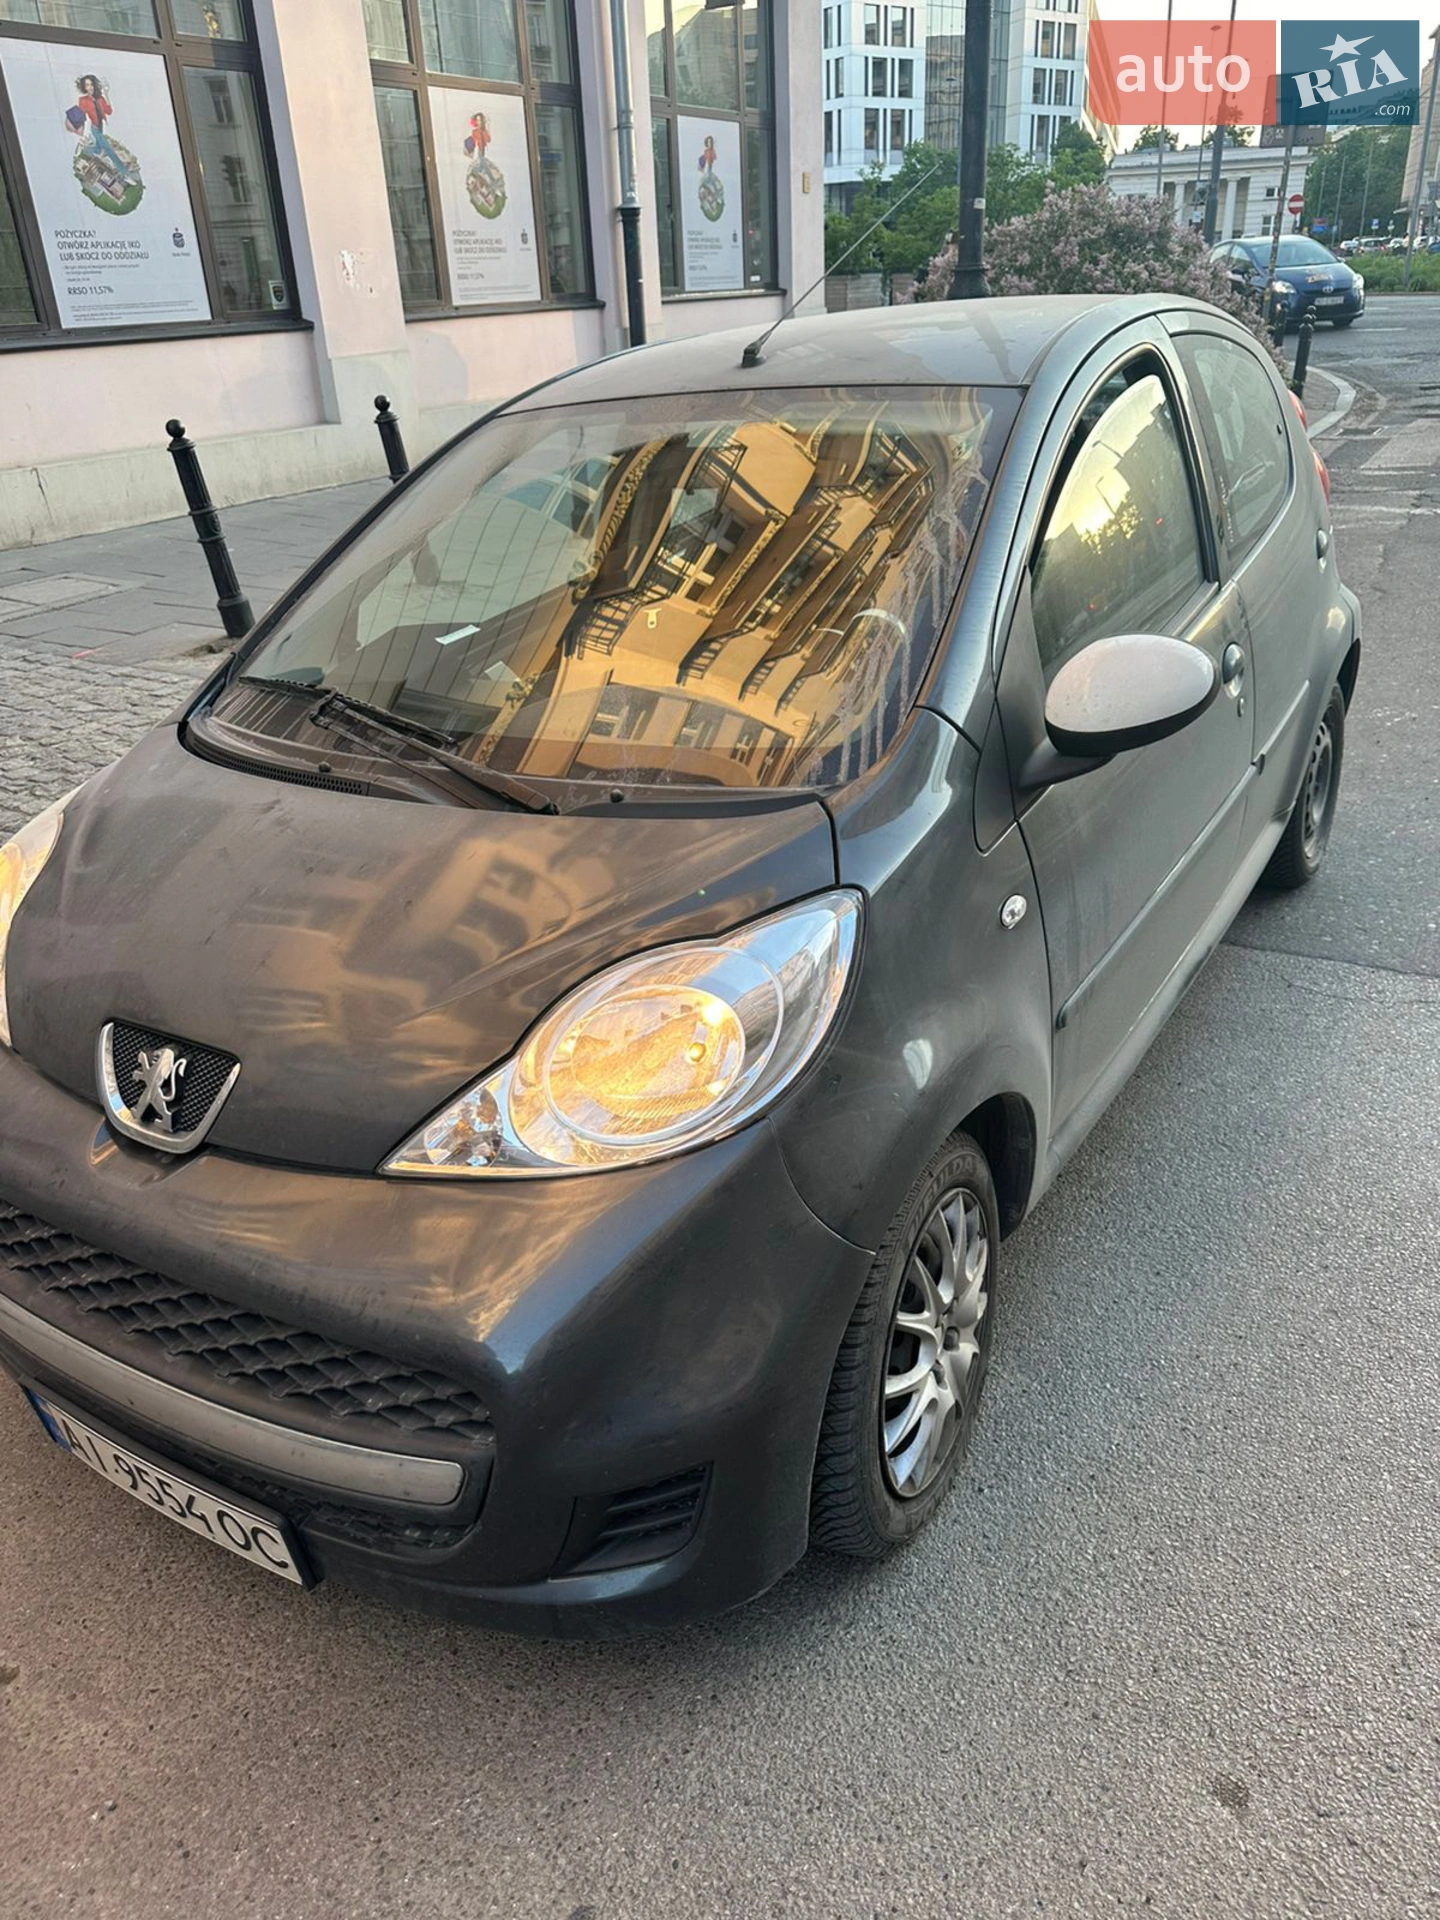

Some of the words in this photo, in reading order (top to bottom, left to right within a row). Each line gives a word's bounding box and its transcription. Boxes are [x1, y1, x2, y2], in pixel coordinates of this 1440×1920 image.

[54, 229, 96, 238] POŻYCZKA?
[57, 240, 89, 250] OTWÓRZ
[90, 240, 128, 251] APLIKACJĘ
[128, 240, 141, 249] IKO
[59, 252, 75, 261] LUB
[76, 252, 100, 261] SKOCZ
[102, 252, 113, 260] DO
[114, 251, 150, 260] ODDZIAŁU
[67, 286, 88, 295] RRSO
[61, 1417, 108, 1473] AI
[113, 1453, 215, 1535] 9554
[216, 1509, 289, 1569] OC
